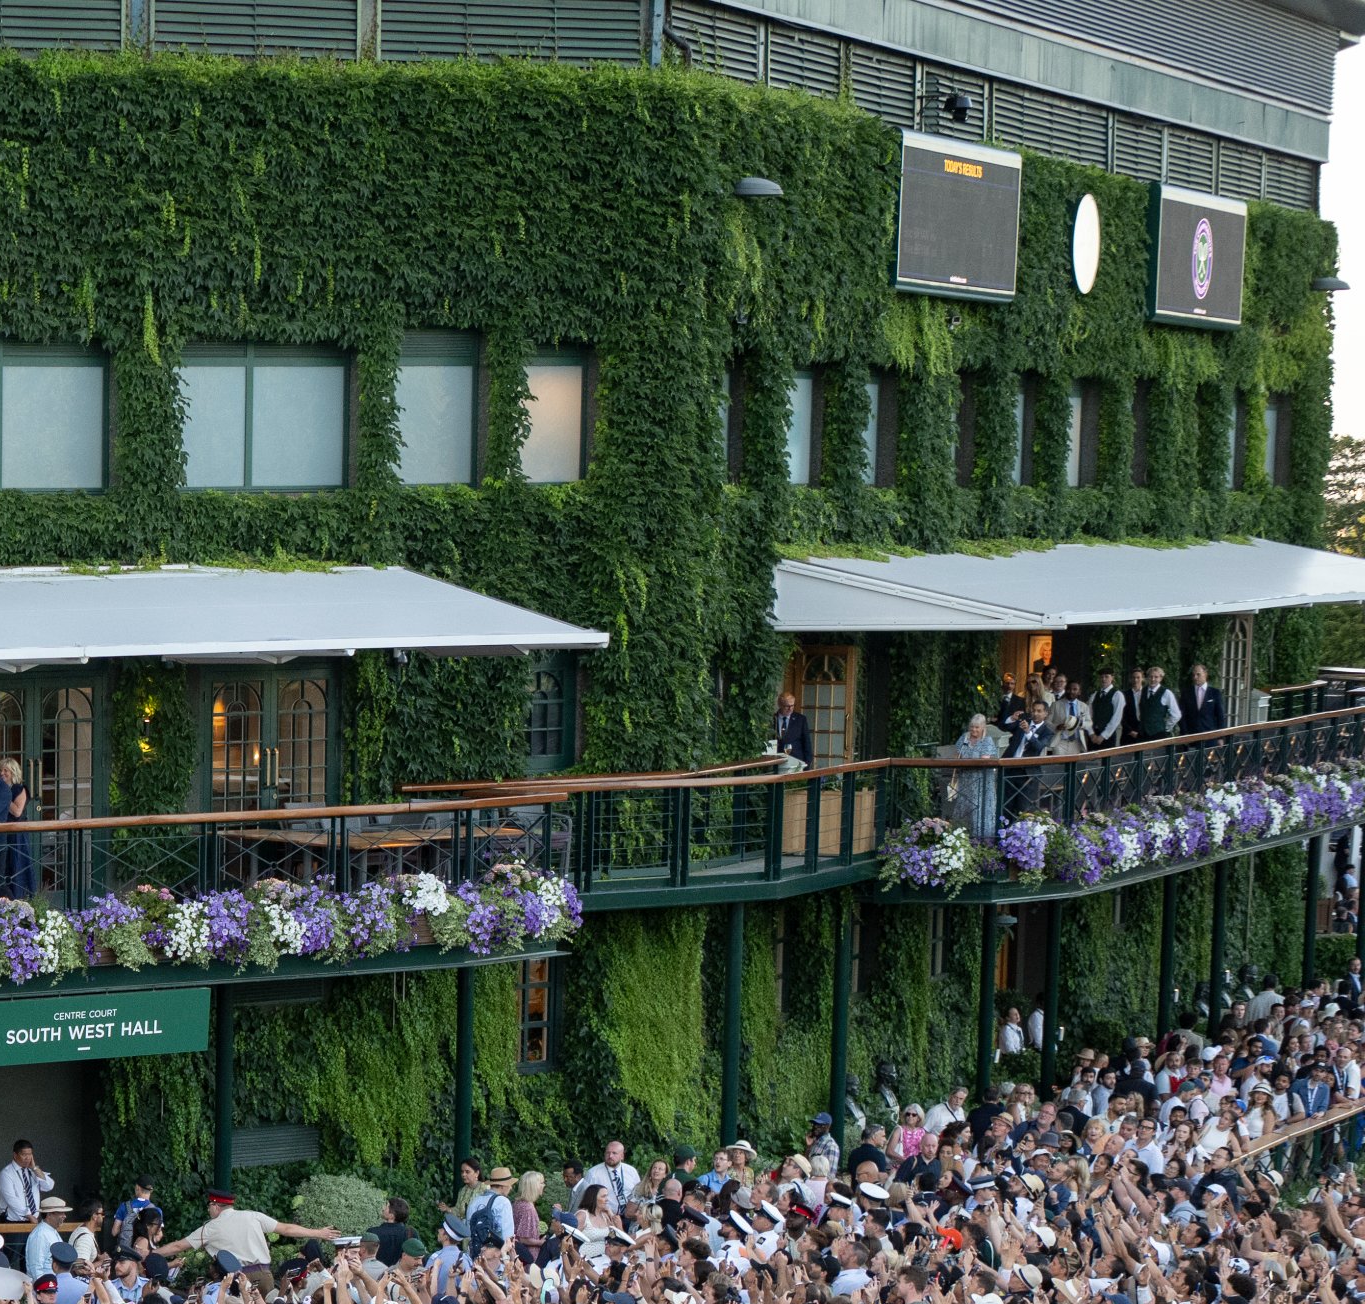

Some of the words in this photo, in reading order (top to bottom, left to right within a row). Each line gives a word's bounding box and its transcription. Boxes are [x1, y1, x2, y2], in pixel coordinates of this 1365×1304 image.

[53, 1011, 87, 1021] CENTRE
[89, 1008, 118, 1018] COURT
[6, 1027, 62, 1045] SOUTH
[68, 1023, 115, 1040] WEST
[121, 1019, 163, 1037] HALL
